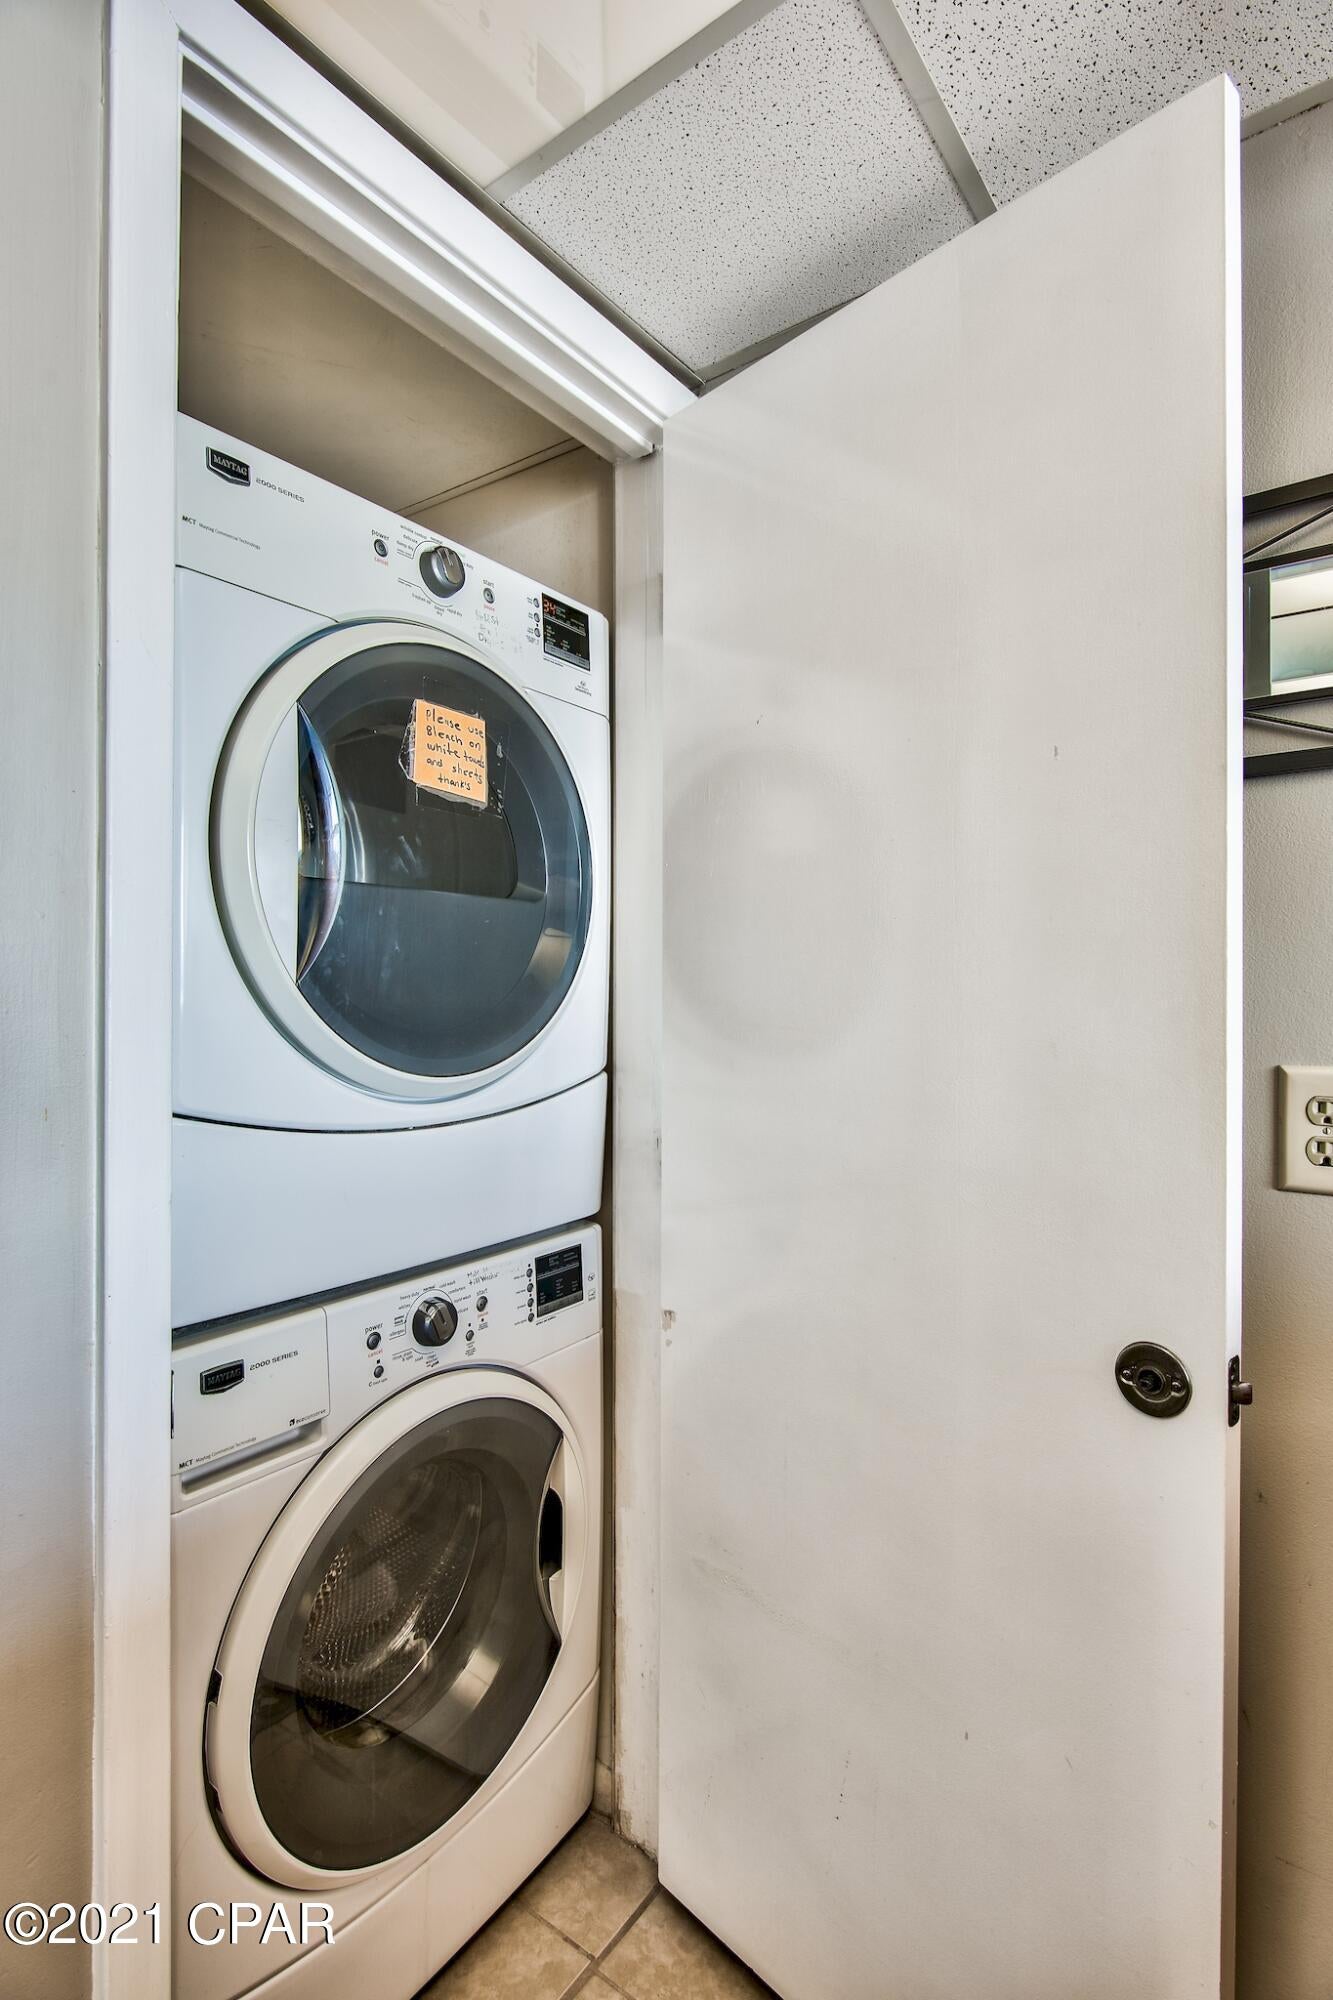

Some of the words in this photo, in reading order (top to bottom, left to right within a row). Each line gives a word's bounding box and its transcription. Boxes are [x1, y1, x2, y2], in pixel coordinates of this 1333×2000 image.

[213, 454, 248, 476] MAYTAG
[256, 477, 277, 491] 2000
[278, 486, 305, 503] SERIES
[182, 515, 197, 526] MCT
[371, 529, 390, 541] power
[482, 579, 495, 589] start
[426, 725, 463, 746] Bleach
[469, 741, 481, 751] on
[468, 726, 485, 739] use
[427, 742, 461, 759] white
[426, 758, 443, 767] and
[452, 762, 483, 785] sheets
[365, 1322, 383, 1334] power
[250, 1359, 271, 1370] 2000
[272, 1350, 299, 1363] SERIES
[207, 1367, 242, 1387] MAYTAG
[178, 1458, 194, 1469] MCT
[195, 1454, 211, 1464] Maytag
